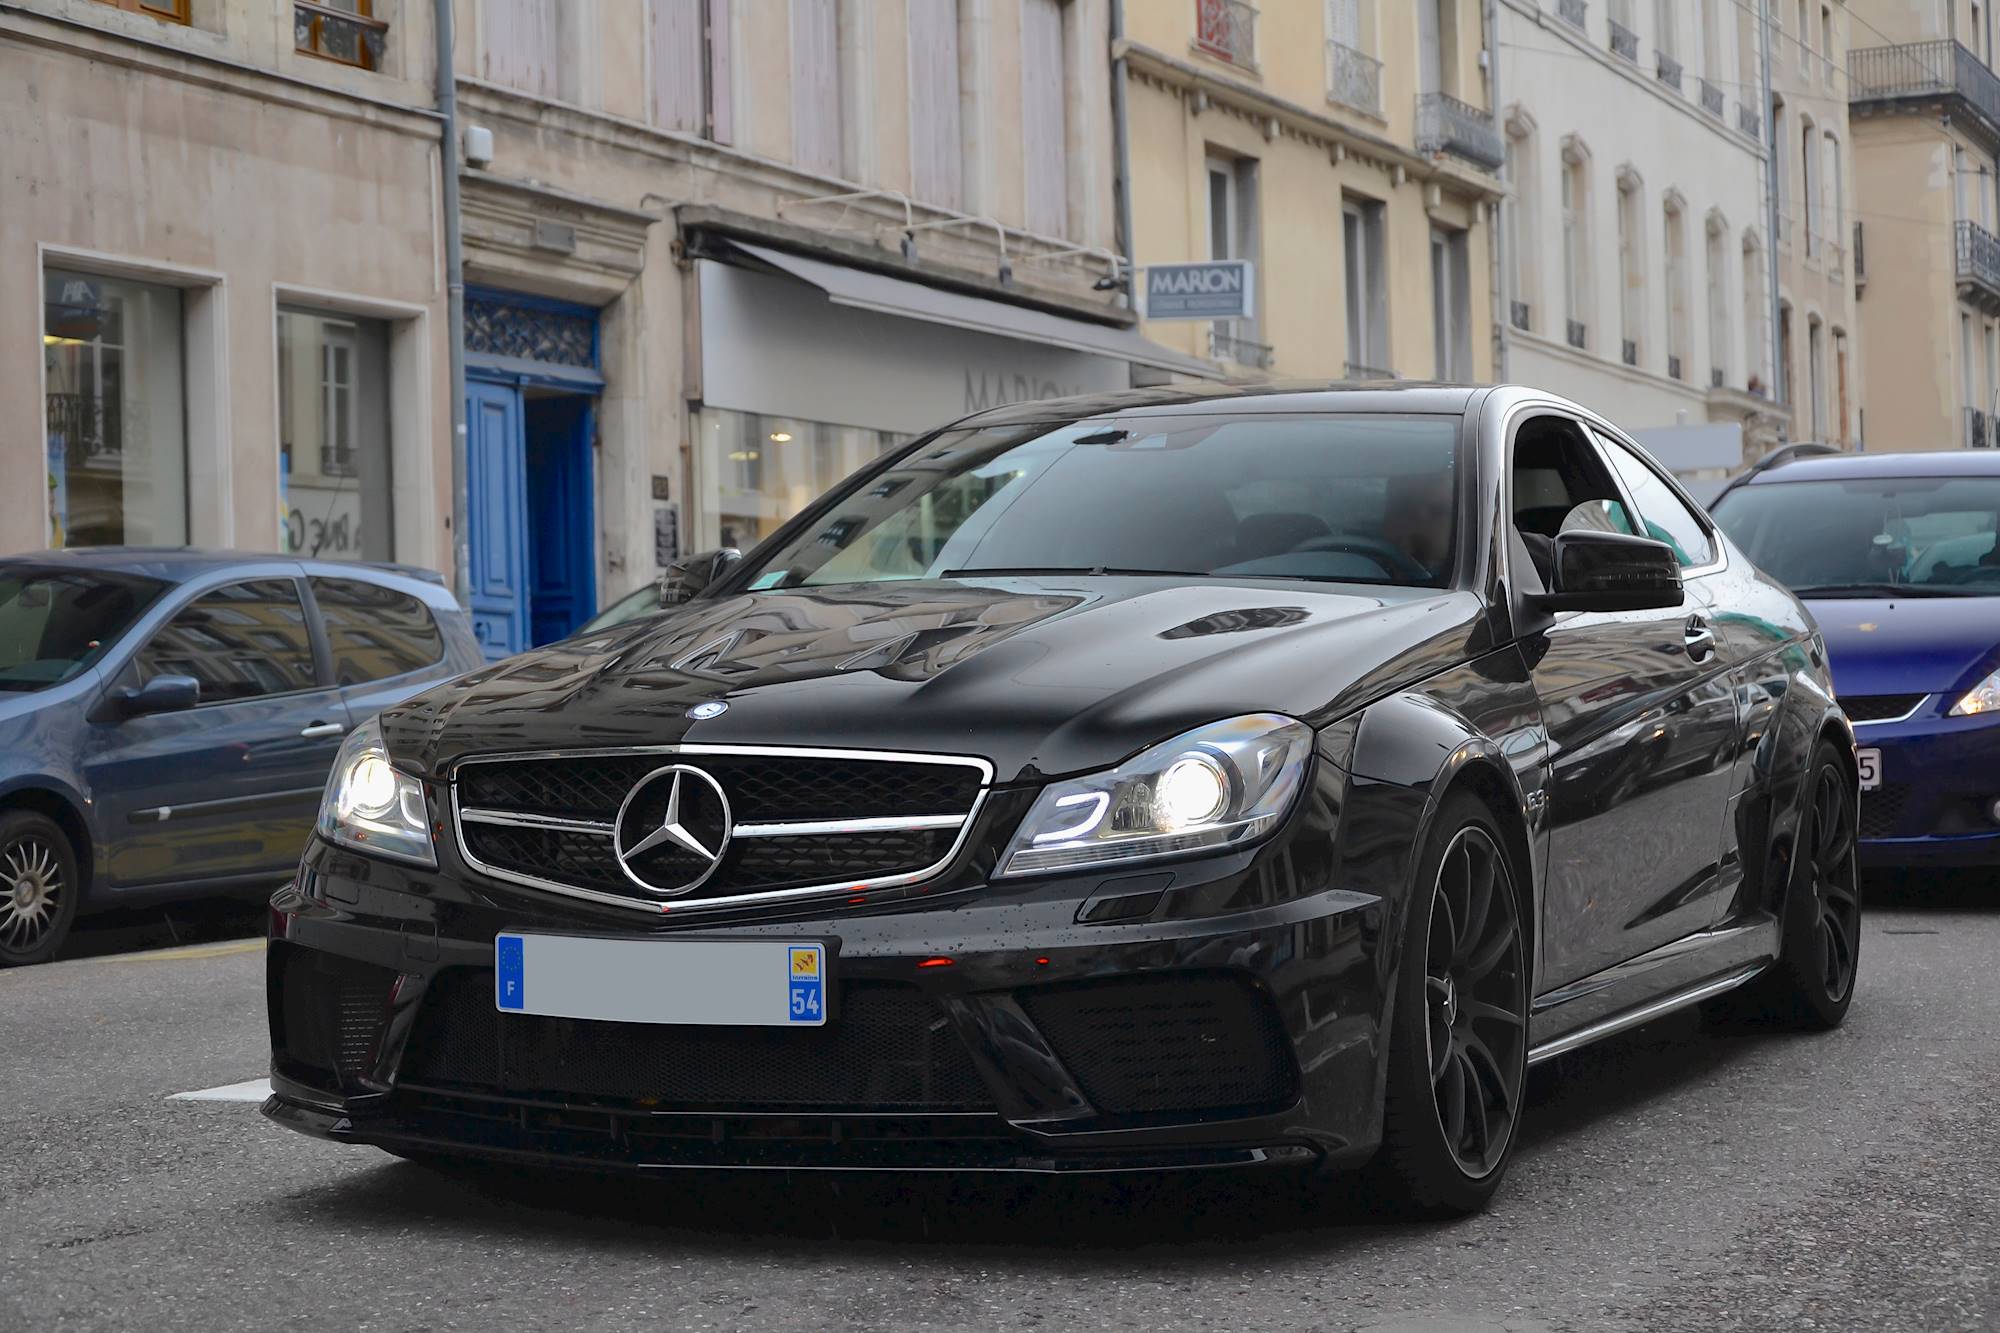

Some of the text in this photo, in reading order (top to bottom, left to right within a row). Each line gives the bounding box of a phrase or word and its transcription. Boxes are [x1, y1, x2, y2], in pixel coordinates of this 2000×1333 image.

[1151, 268, 1240, 294] MARION
[507, 981, 515, 996] F
[792, 988, 819, 1015] 54
